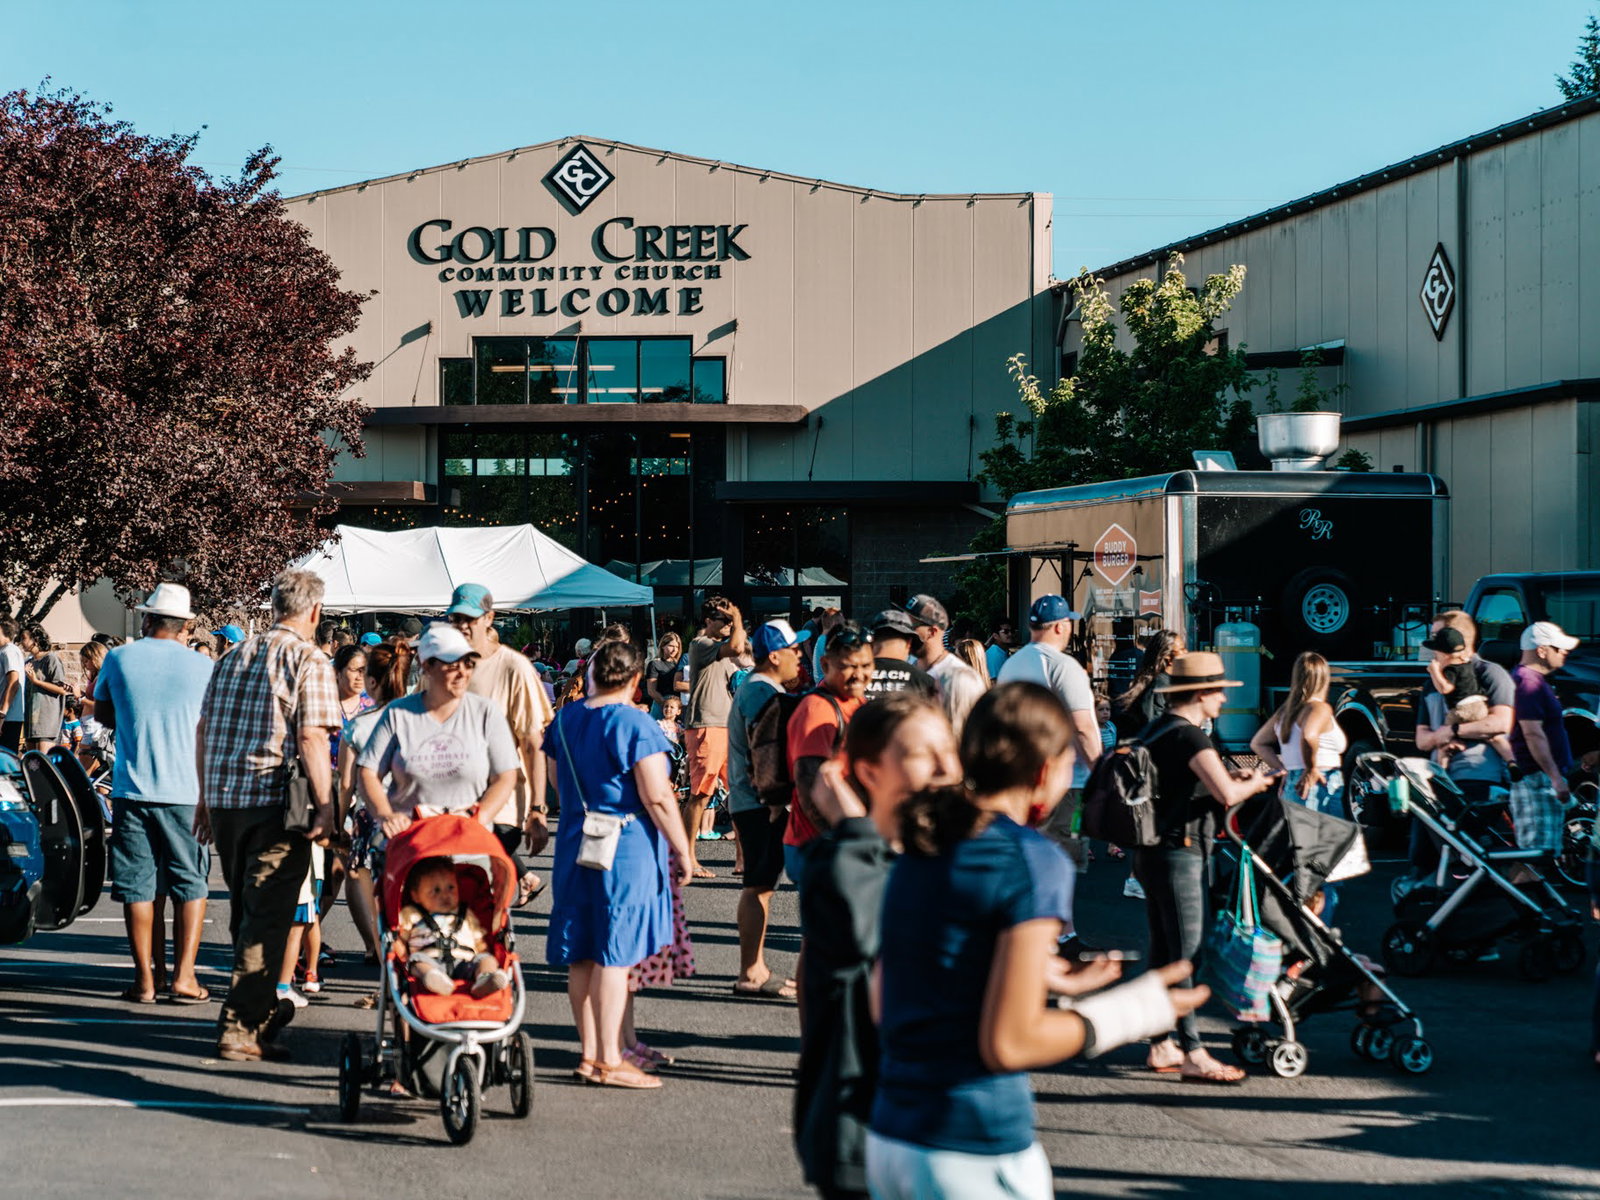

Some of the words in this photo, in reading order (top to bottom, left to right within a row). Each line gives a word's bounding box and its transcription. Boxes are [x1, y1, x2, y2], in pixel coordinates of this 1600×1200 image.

[407, 218, 557, 265] GOLD
[591, 216, 752, 263] CREEK
[438, 265, 604, 283] COMMUNITY
[614, 264, 722, 281] CHURCH
[453, 287, 704, 319] WELCOME
[1104, 541, 1127, 553] BUDDY
[1102, 554, 1129, 567] BURGER
